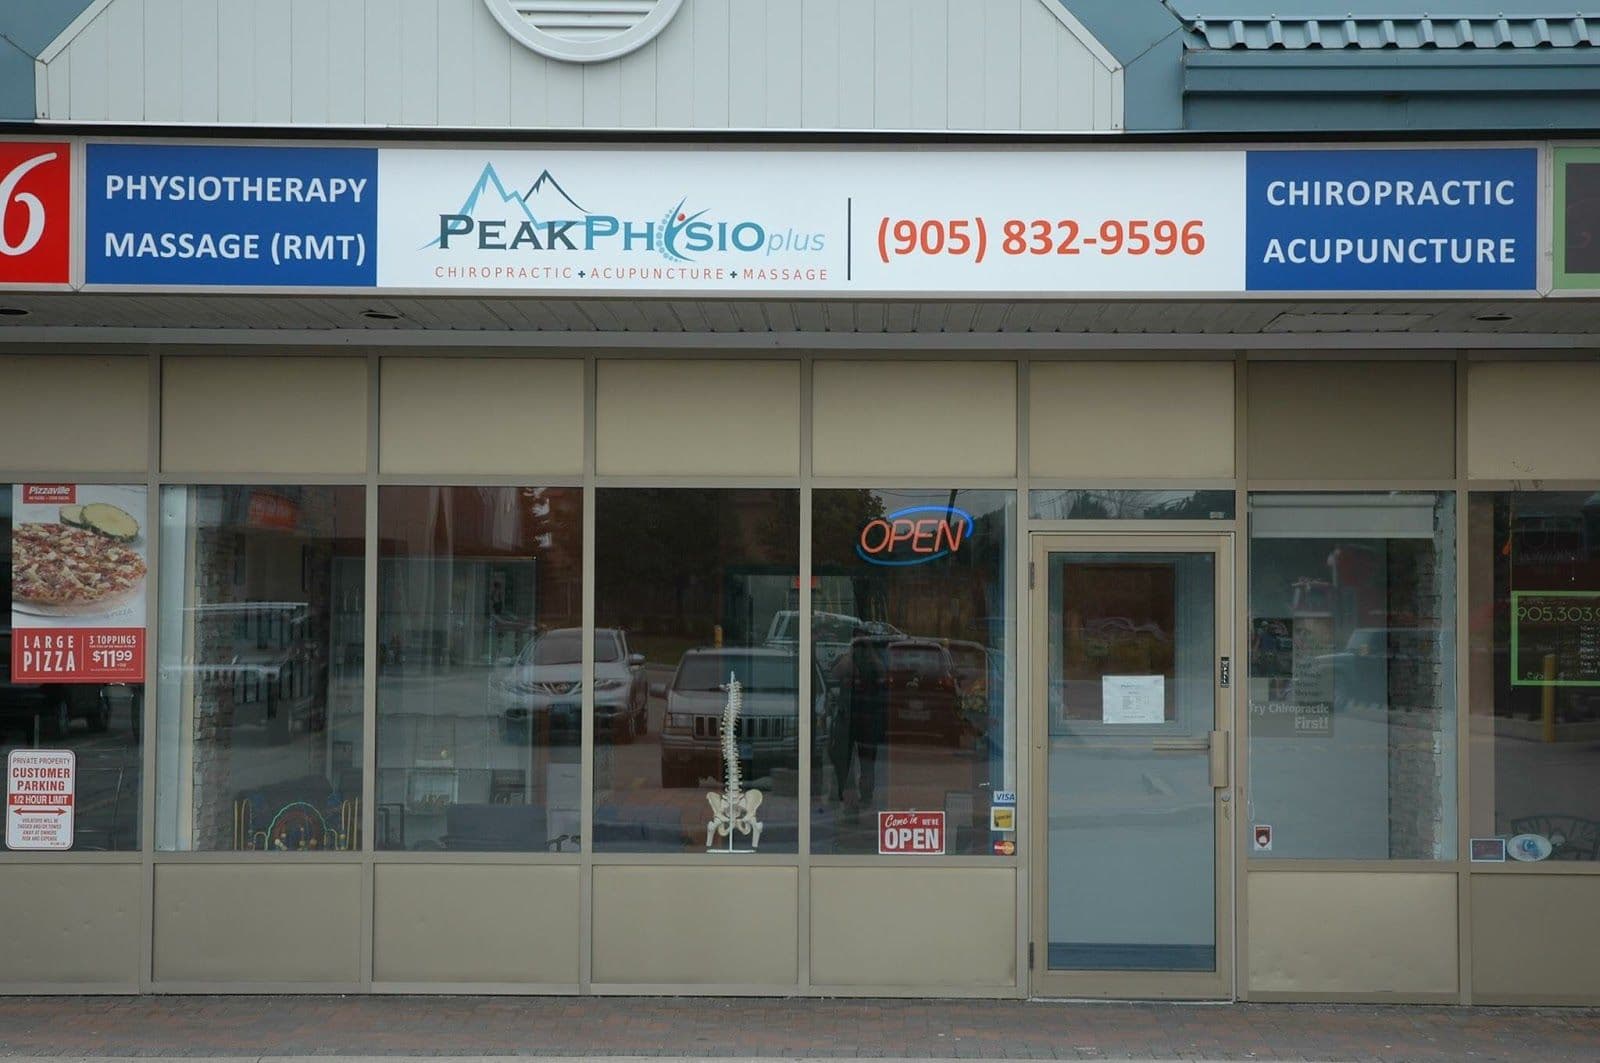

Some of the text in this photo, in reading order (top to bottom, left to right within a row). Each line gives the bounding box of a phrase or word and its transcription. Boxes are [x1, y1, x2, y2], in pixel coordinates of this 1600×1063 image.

[106, 175, 367, 203] PHYSIOTHERAPY
[1266, 179, 1515, 206] CHIROPRACTIC
[766, 227, 826, 257] plus
[877, 217, 1206, 263] (905) 832-9596
[105, 231, 366, 266] MASSAGE (RMT)
[1263, 237, 1516, 265] ACUPUNCTURE
[434, 265, 828, 281] CHIROPRACTIC ACUPUNCTURE MASSAGE
[28, 486, 71, 495] Pizzaville
[861, 519, 965, 553] OPEN
[23, 635, 75, 649] LARGE
[97, 635, 137, 645] TOPPINGS
[23, 651, 76, 672] PIZZA
[1268, 703, 1329, 714] Chiropractic
[12, 767, 71, 778] CUSTOMER
[17, 781, 65, 791] PARKING
[25, 795, 48, 804] HOUR
[49, 795, 69, 804] LIMIT
[996, 793, 1015, 801] VISA
[885, 814, 908, 828] Come
[909, 813, 918, 824] in
[884, 828, 939, 849] OPEN
